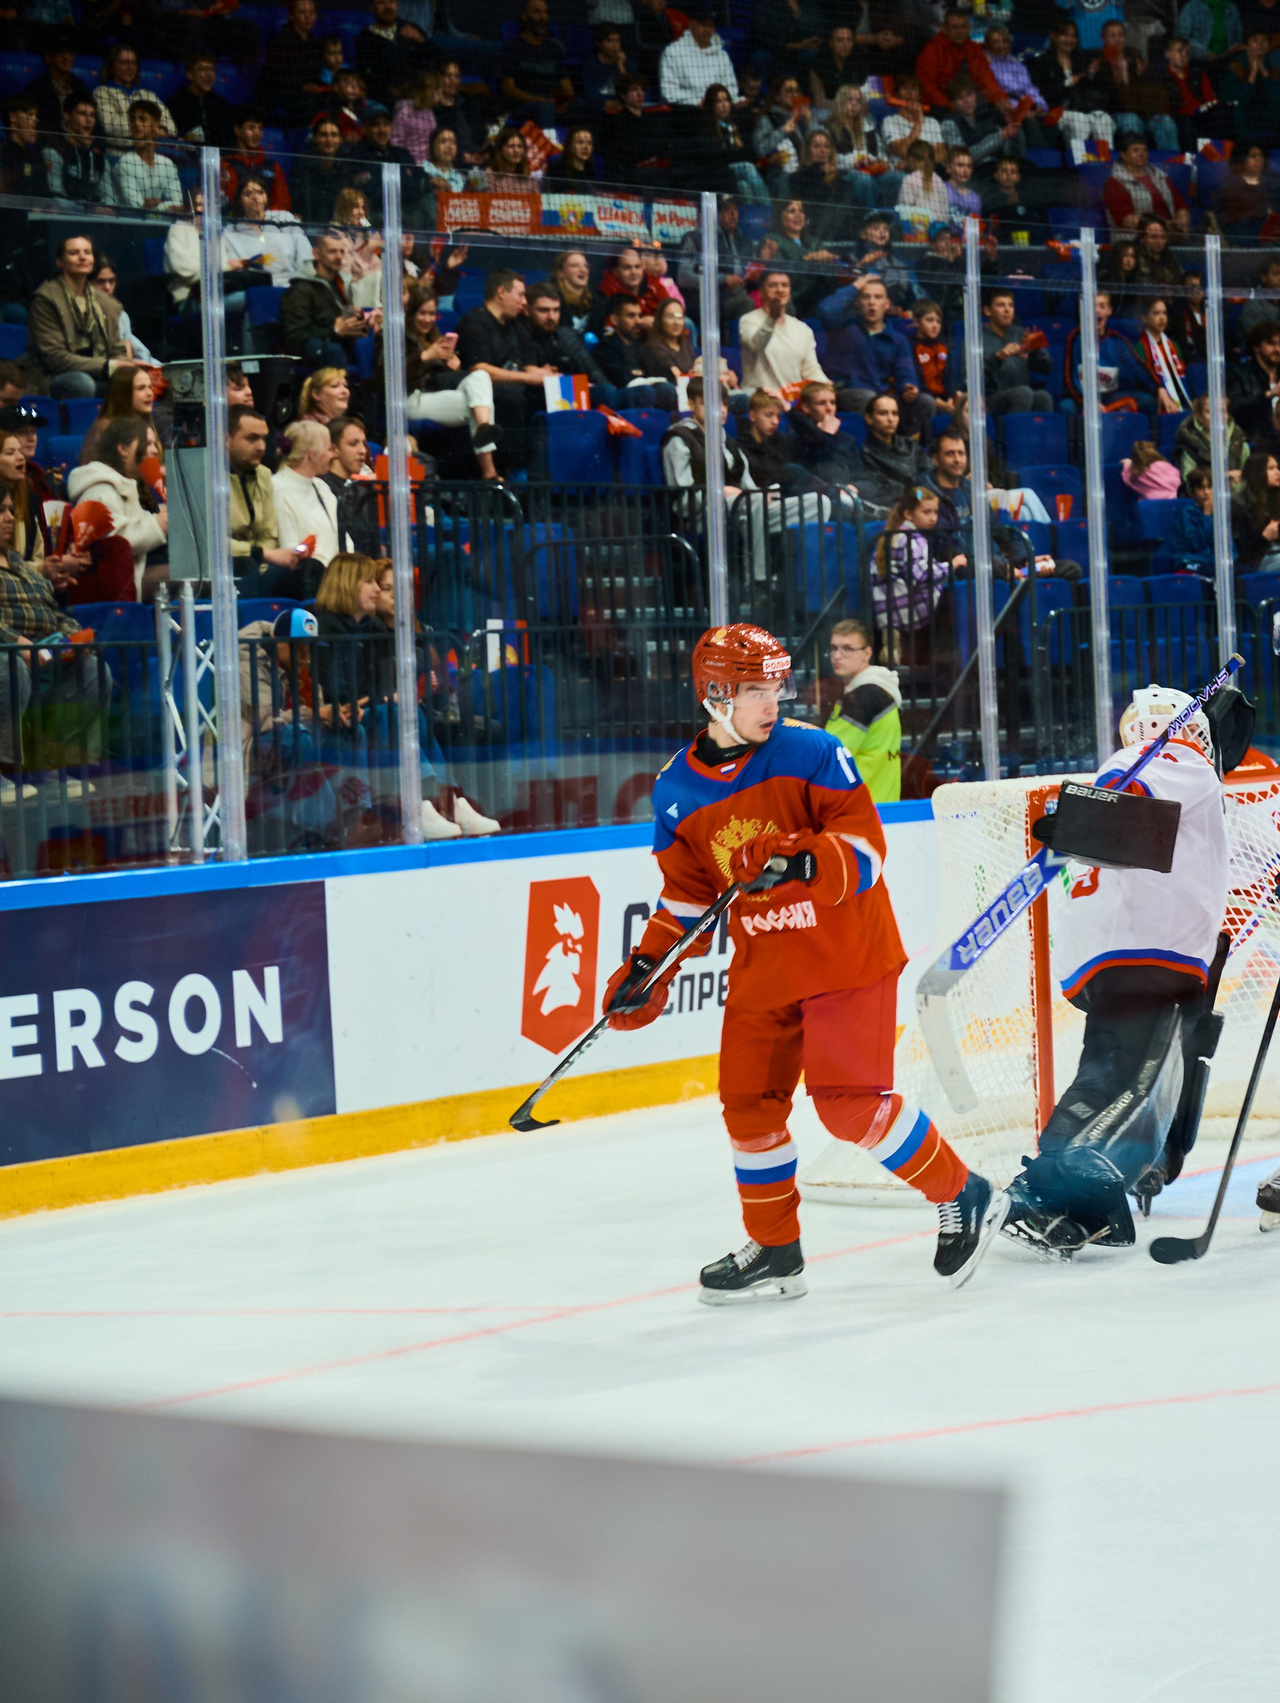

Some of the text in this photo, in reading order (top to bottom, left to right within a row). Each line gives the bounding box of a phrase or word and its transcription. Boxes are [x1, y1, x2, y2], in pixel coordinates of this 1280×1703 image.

[1167, 667, 1229, 740] SHADOW
[1064, 784, 1120, 804] BAUER
[740, 900, 818, 937] РОССИЯ
[956, 862, 1045, 965] BAUER
[0, 965, 284, 1080] ERSON
